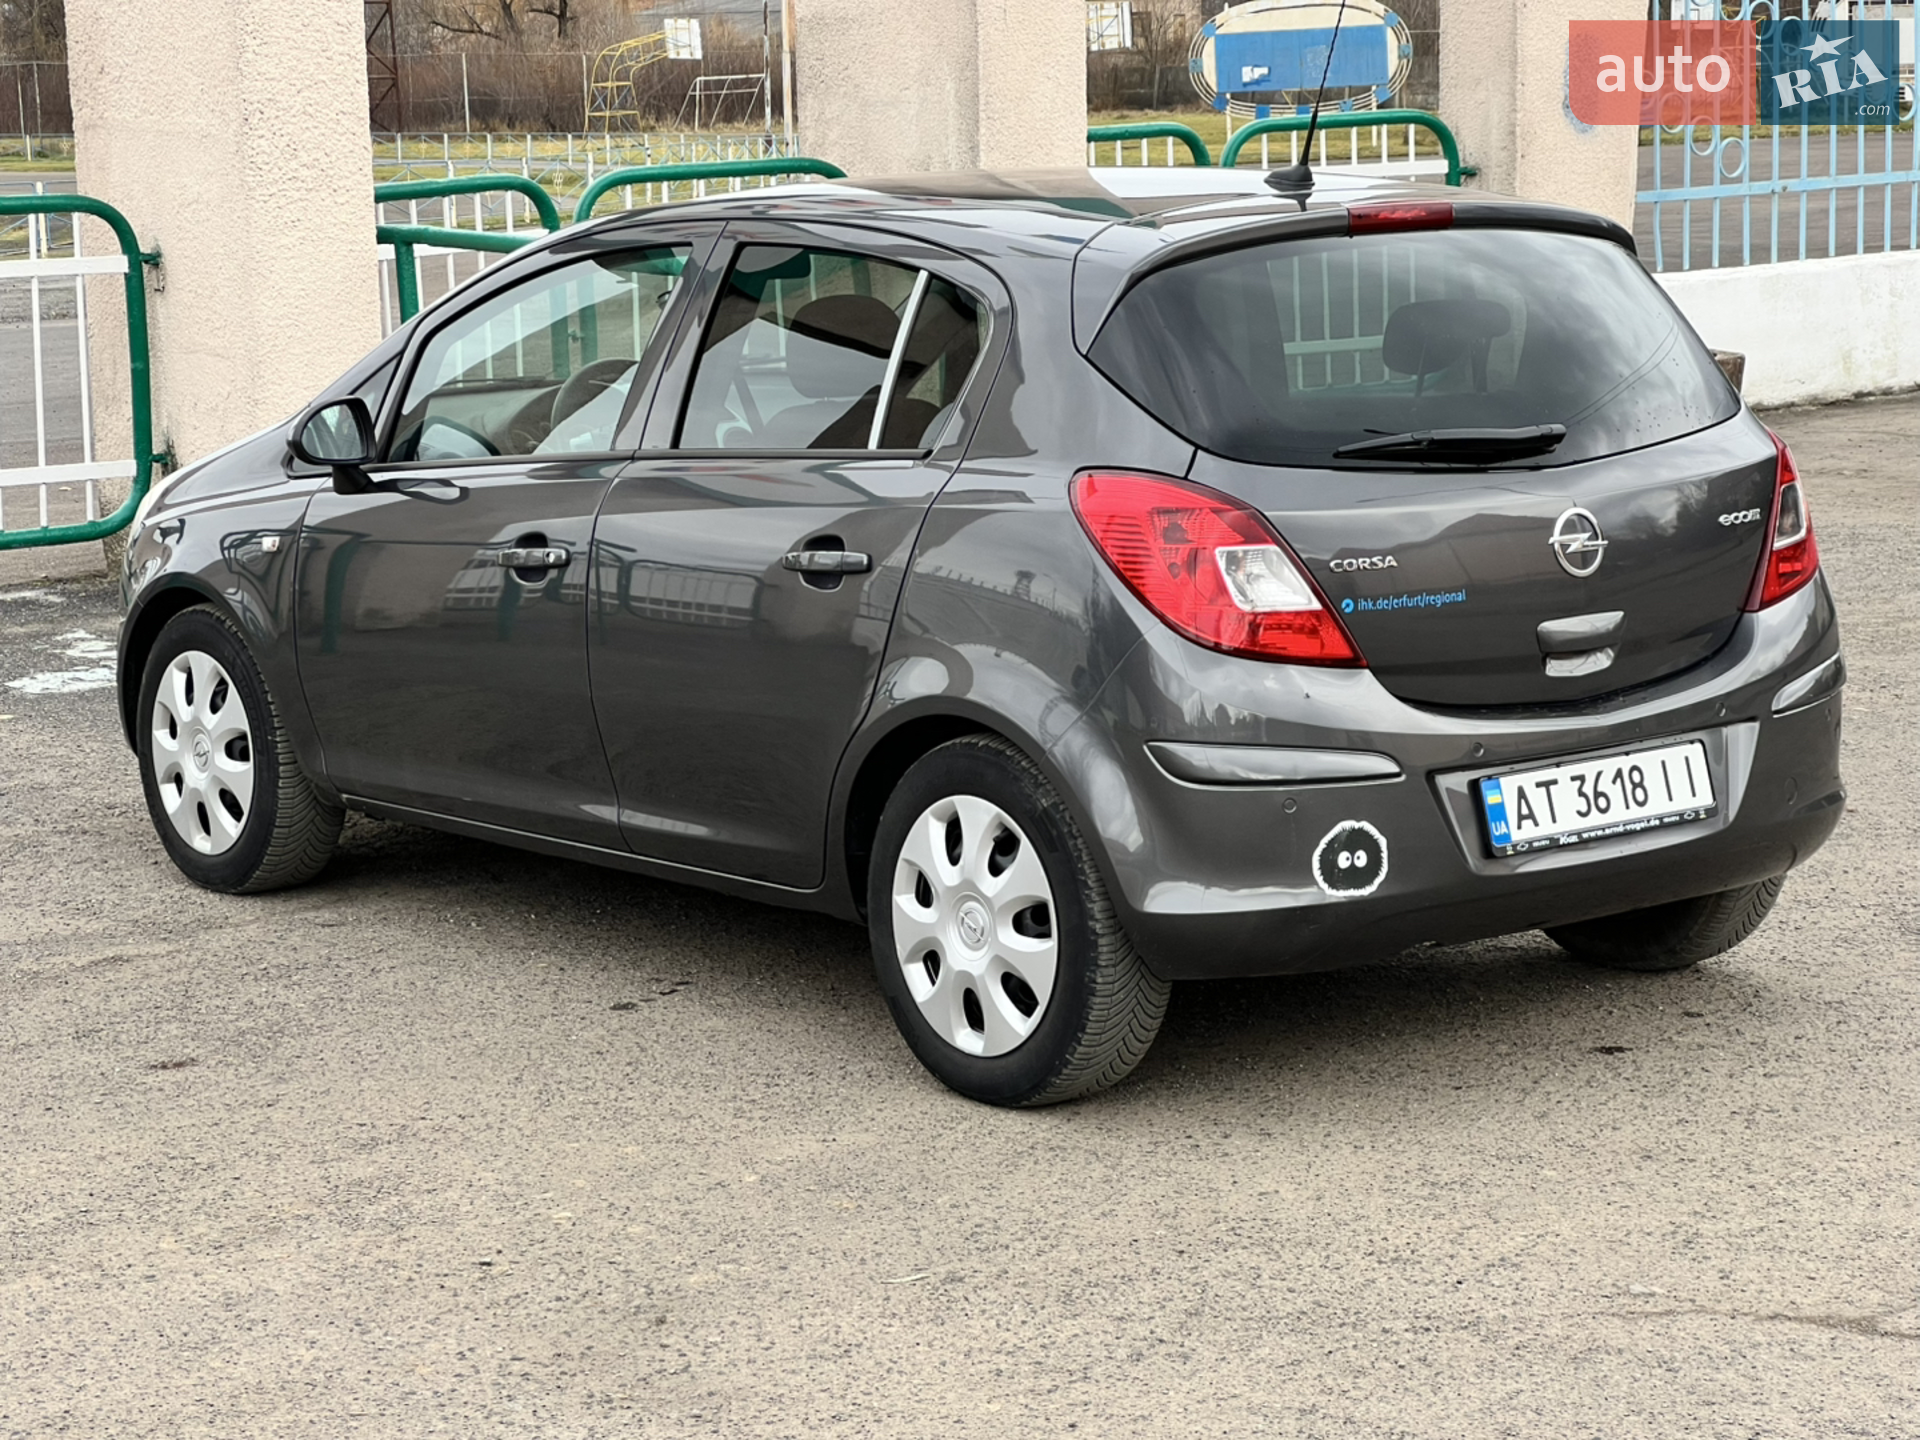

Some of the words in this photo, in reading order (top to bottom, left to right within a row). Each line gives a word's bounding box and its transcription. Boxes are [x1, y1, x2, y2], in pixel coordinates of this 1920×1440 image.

[1329, 555, 1399, 573] CORSA
[1357, 588, 1467, 611] ihk.de/erfurt/regional
[1516, 778, 1559, 830] AT
[1570, 764, 1649, 818] 3618
[1491, 820, 1509, 836] UA
